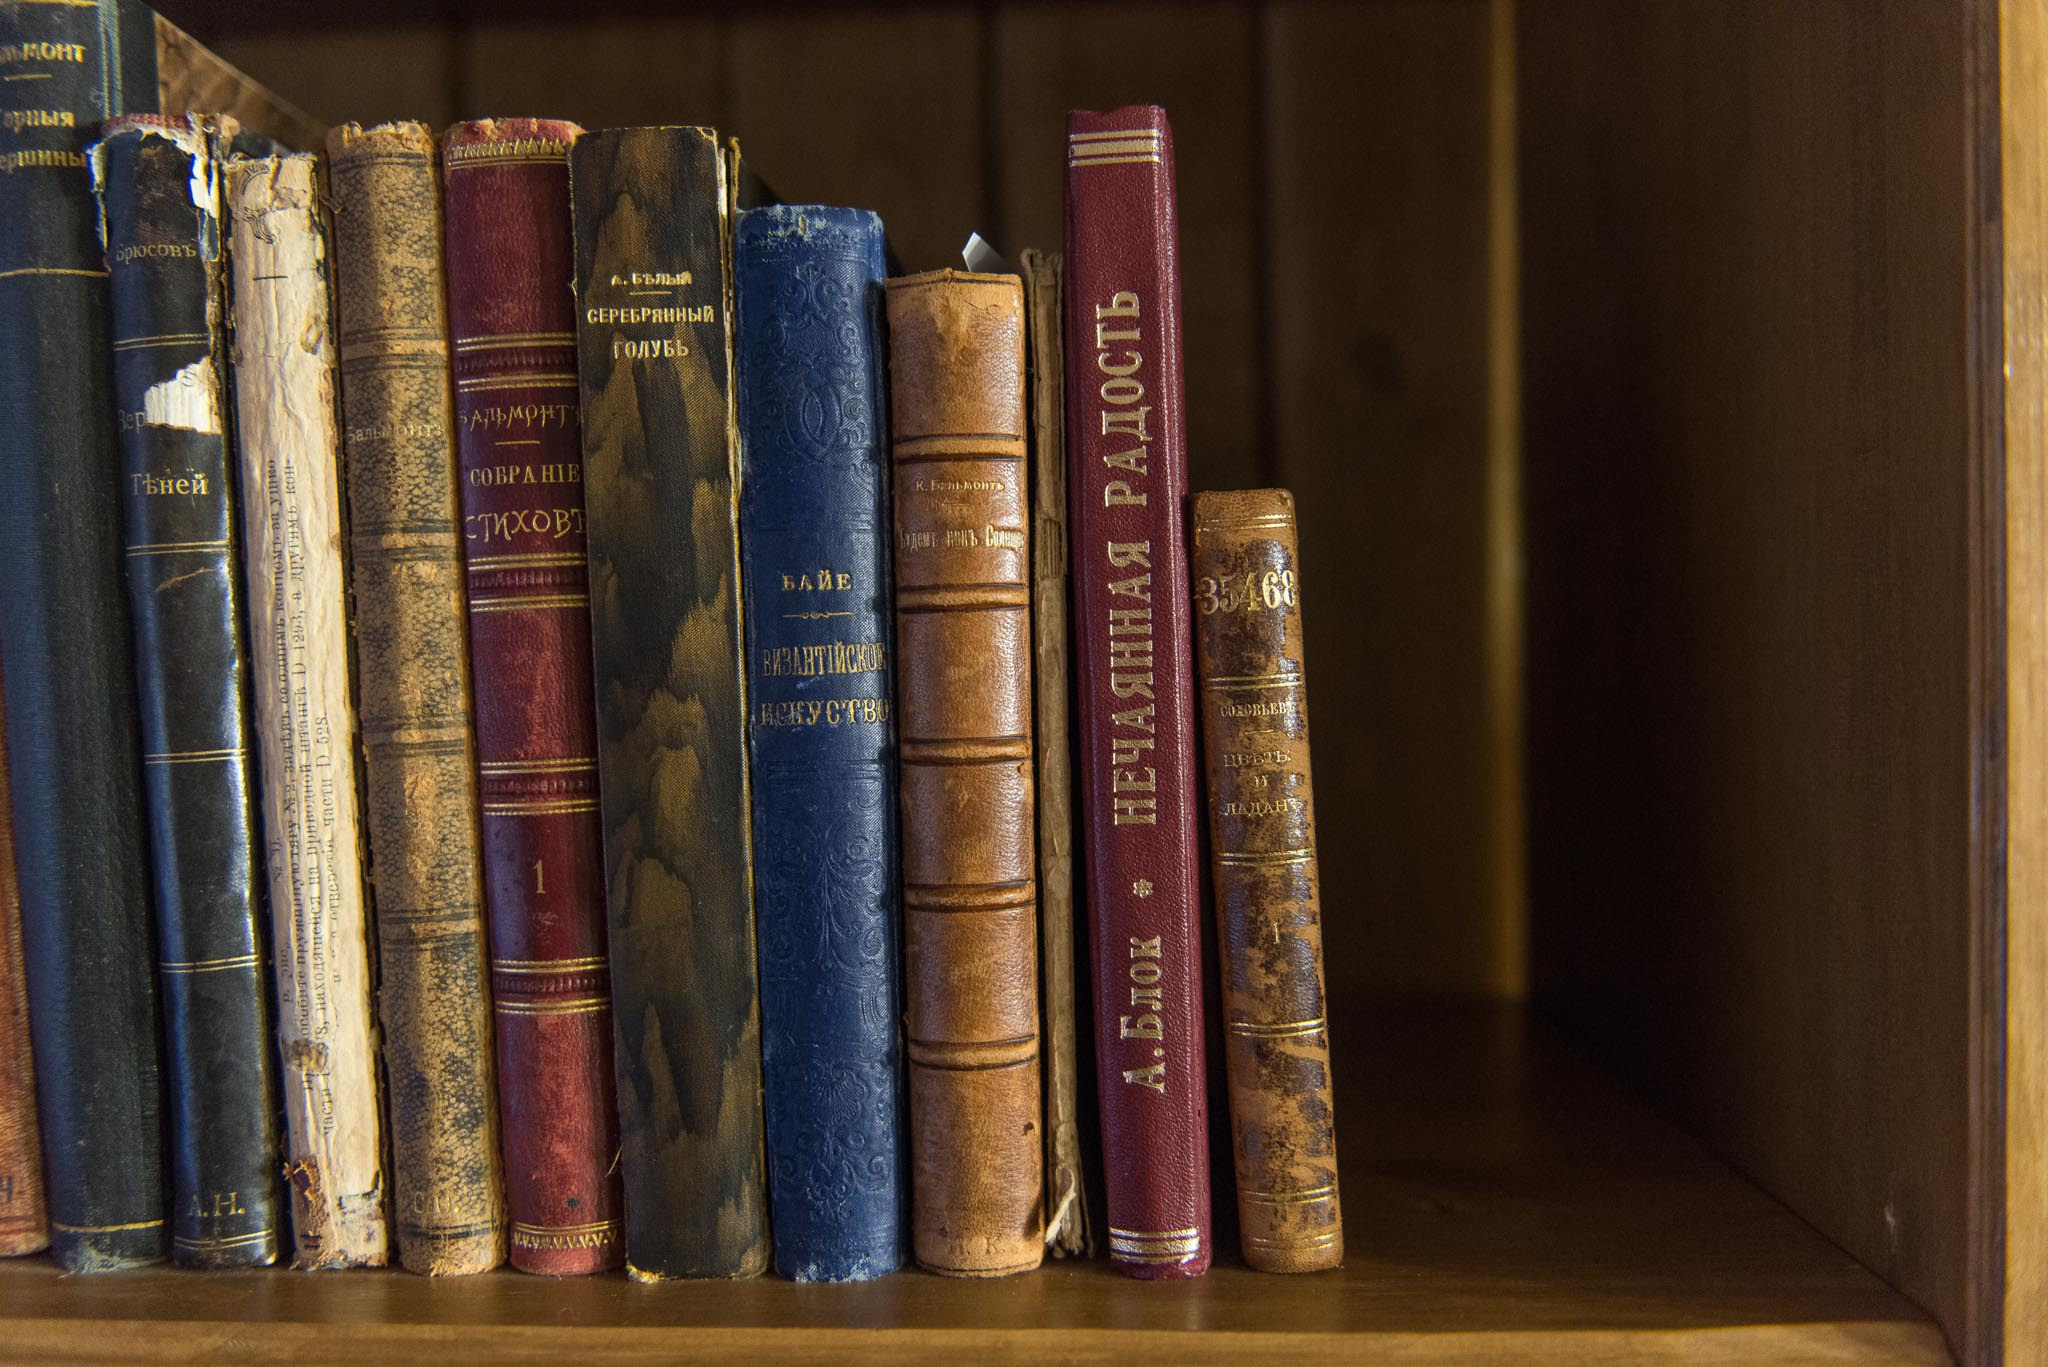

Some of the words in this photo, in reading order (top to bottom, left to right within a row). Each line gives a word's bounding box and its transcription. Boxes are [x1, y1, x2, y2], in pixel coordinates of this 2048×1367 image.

[587, 305, 715, 324] СЕРЕБРЯННЫЙ
[614, 338, 689, 360] ГОЛУБЬ
[1096, 291, 1153, 508] РАДОСТЬ
[470, 463, 581, 487] СОБРАНІЕ
[782, 569, 853, 592] БАЙЕ
[1107, 541, 1157, 825] НЕЧАЯННАЯ
[533, 859, 546, 894] 1
